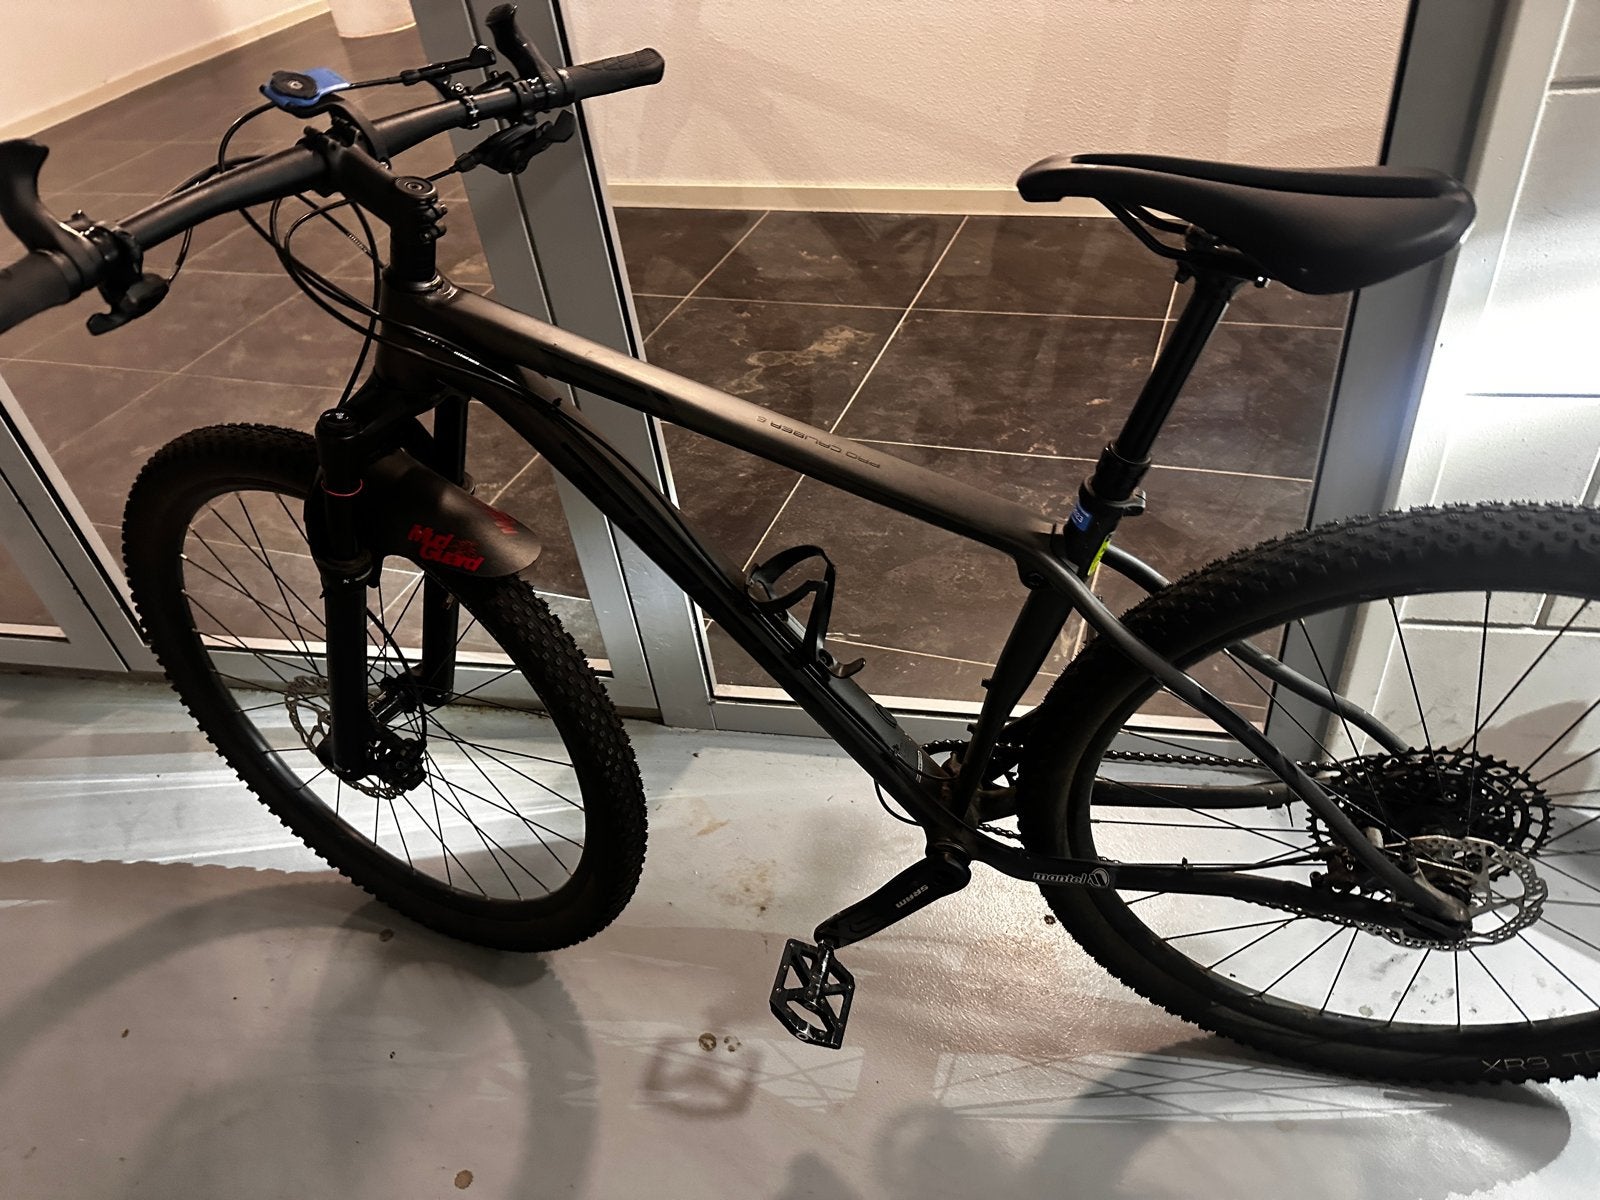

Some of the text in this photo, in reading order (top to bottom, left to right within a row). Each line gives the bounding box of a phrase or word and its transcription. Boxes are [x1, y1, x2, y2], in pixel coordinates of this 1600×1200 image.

[770, 421, 842, 453] CALIBER
[845, 450, 881, 469] PRO
[407, 523, 454, 549] Mud
[418, 544, 485, 571] Guard
[1032, 872, 1087, 884] mantel
[895, 884, 929, 909] SRAM
[1481, 1056, 1550, 1073] XR3
